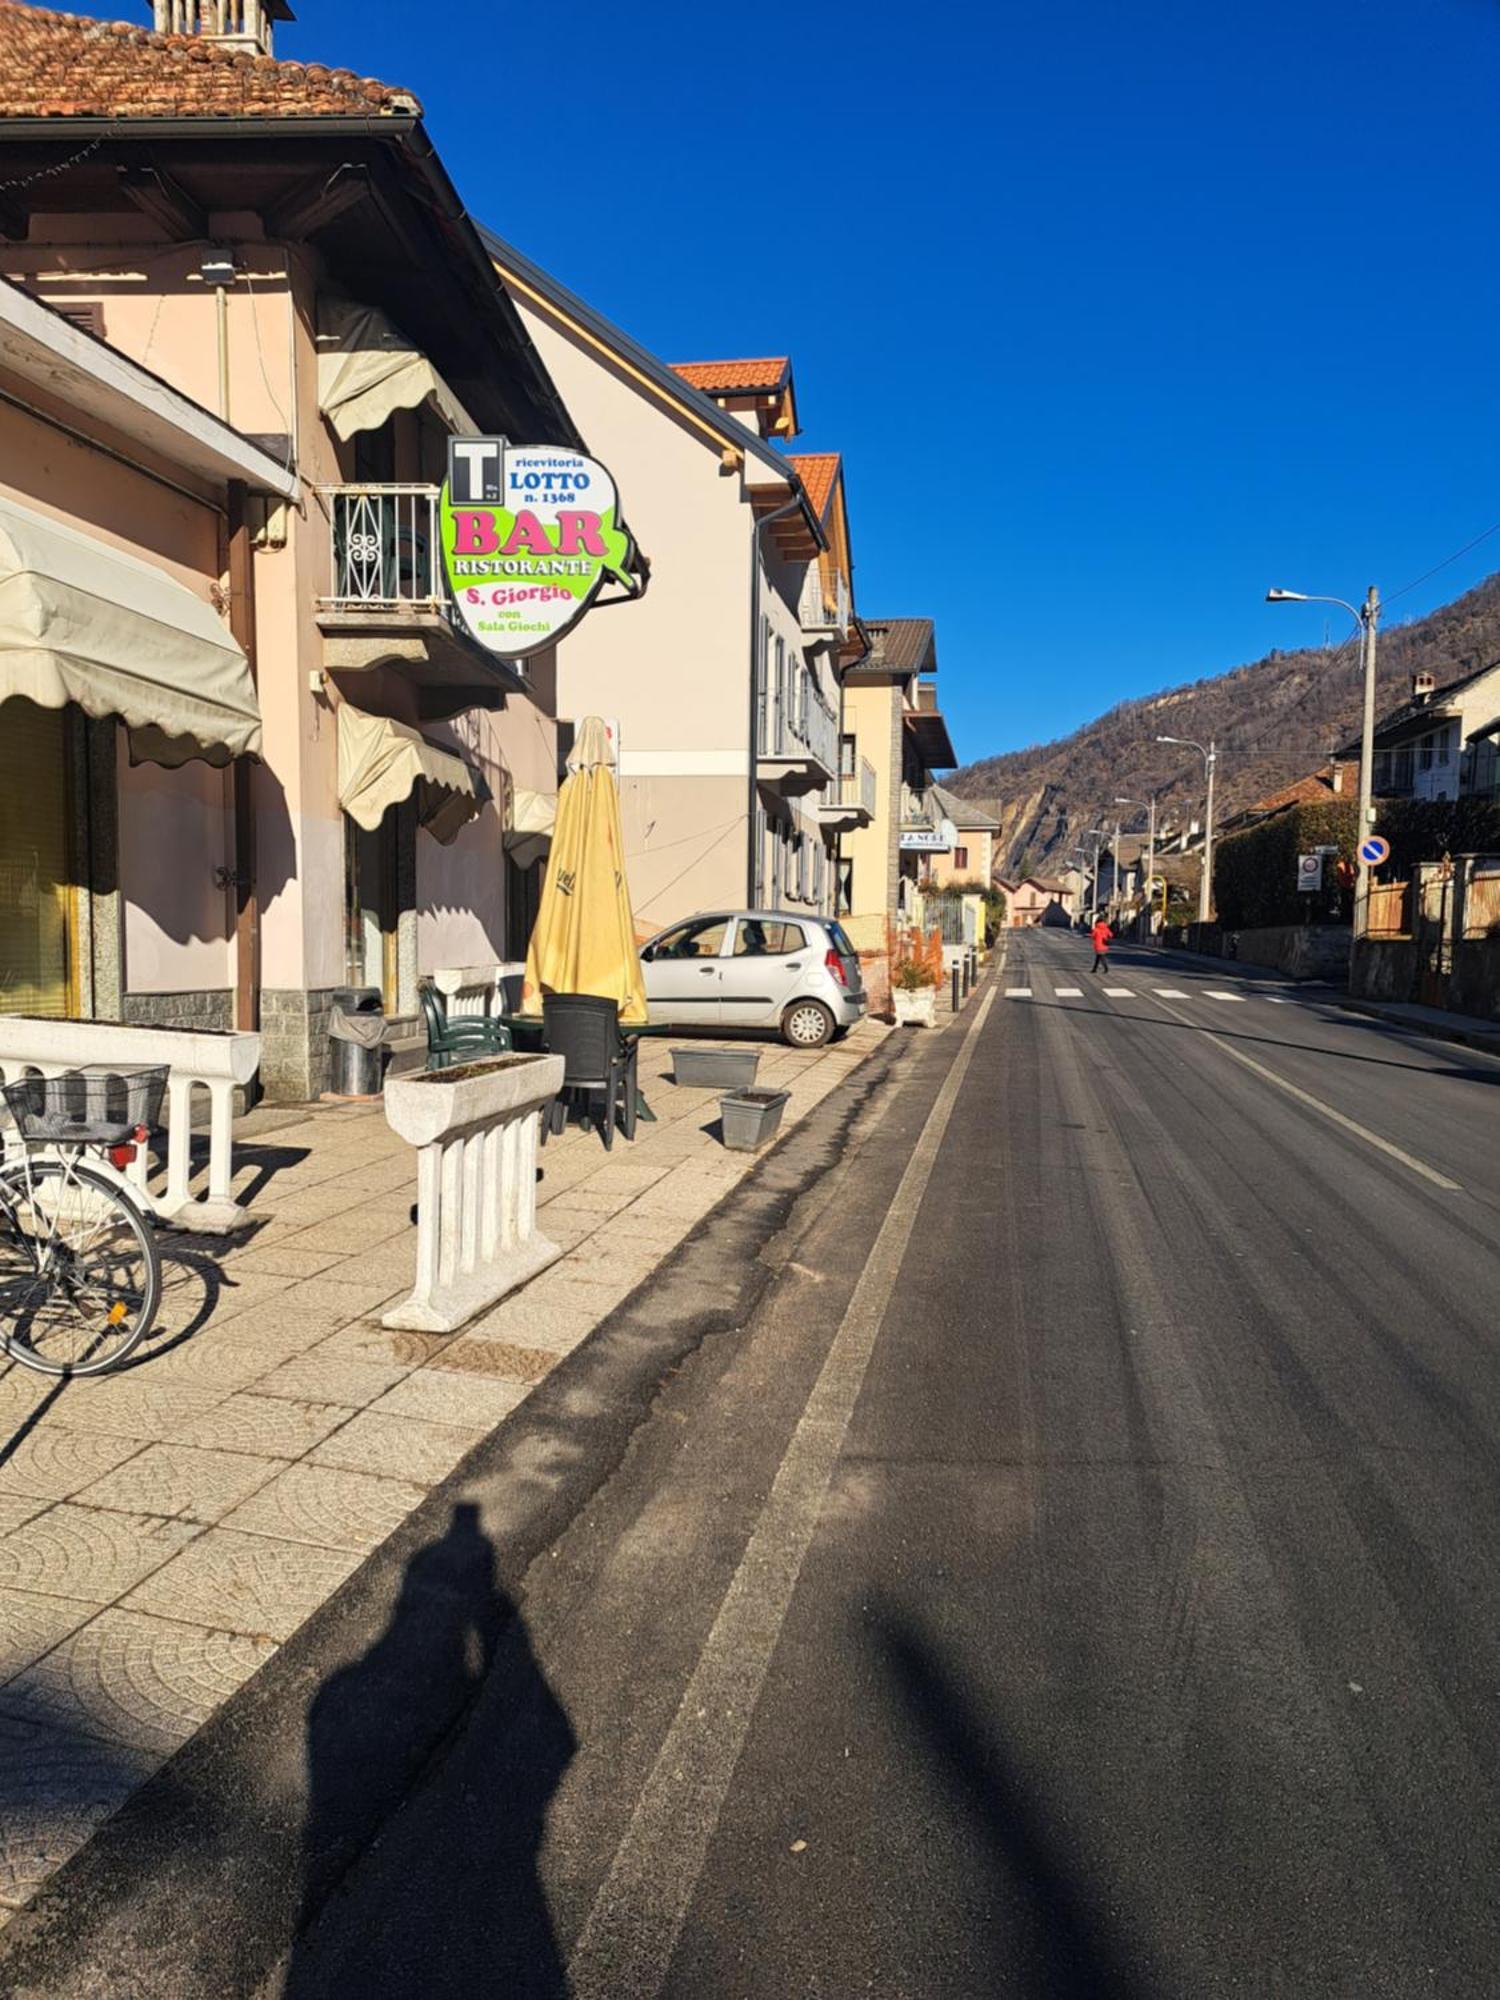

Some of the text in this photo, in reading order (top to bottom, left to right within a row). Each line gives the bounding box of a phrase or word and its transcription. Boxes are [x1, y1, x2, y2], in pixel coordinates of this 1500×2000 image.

[454, 443, 498, 500] T
[515, 458, 584, 468] ricevitoria
[510, 472, 590, 490] LOTTO
[524, 492, 576, 504] n. 1368
[451, 509, 609, 557] BAR
[454, 559, 592, 576] RISTORANTE
[466, 582, 573, 606] S. Giorgio
[498, 610, 521, 620] con
[478, 620, 551, 632] Sala Giochi
